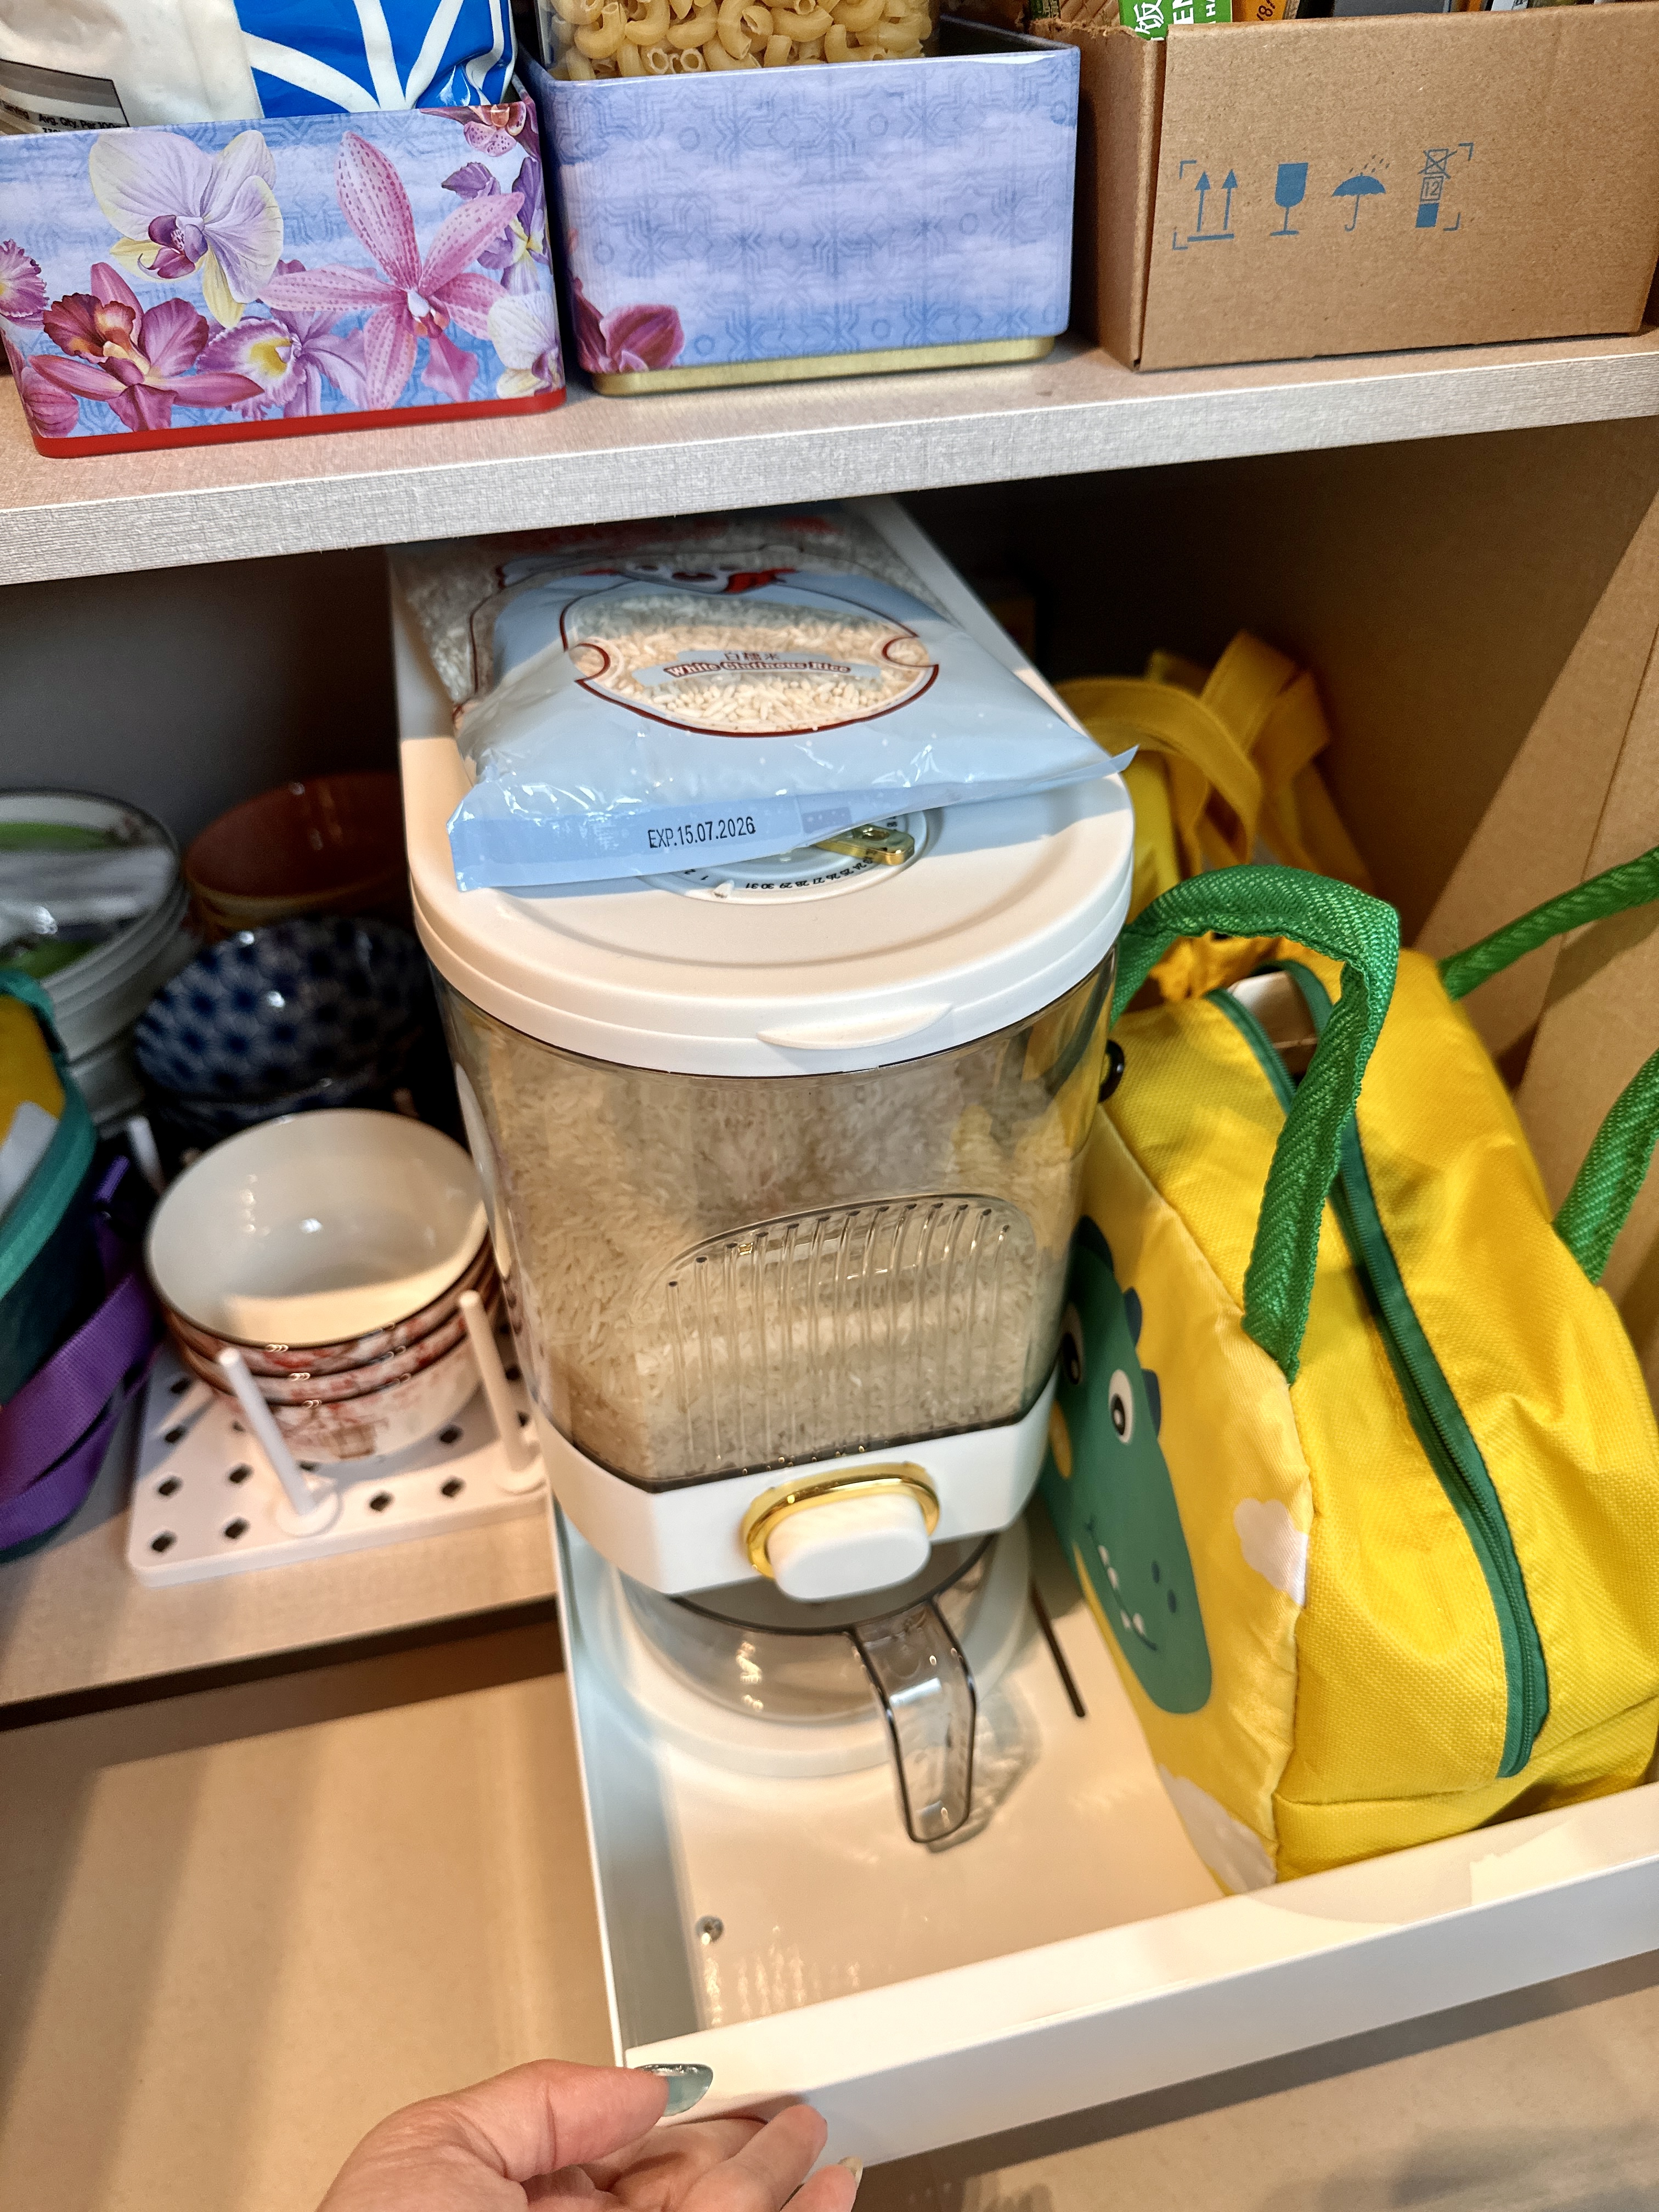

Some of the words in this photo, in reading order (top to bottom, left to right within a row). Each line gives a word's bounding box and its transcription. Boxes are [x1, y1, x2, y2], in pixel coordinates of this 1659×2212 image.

[1425, 181, 1440, 196] 12
[664, 662, 721, 678] White
[808, 661, 851, 673] Rice
[647, 816, 756, 849] EXP.15.07.2026
[840, 868, 854, 877] 25
